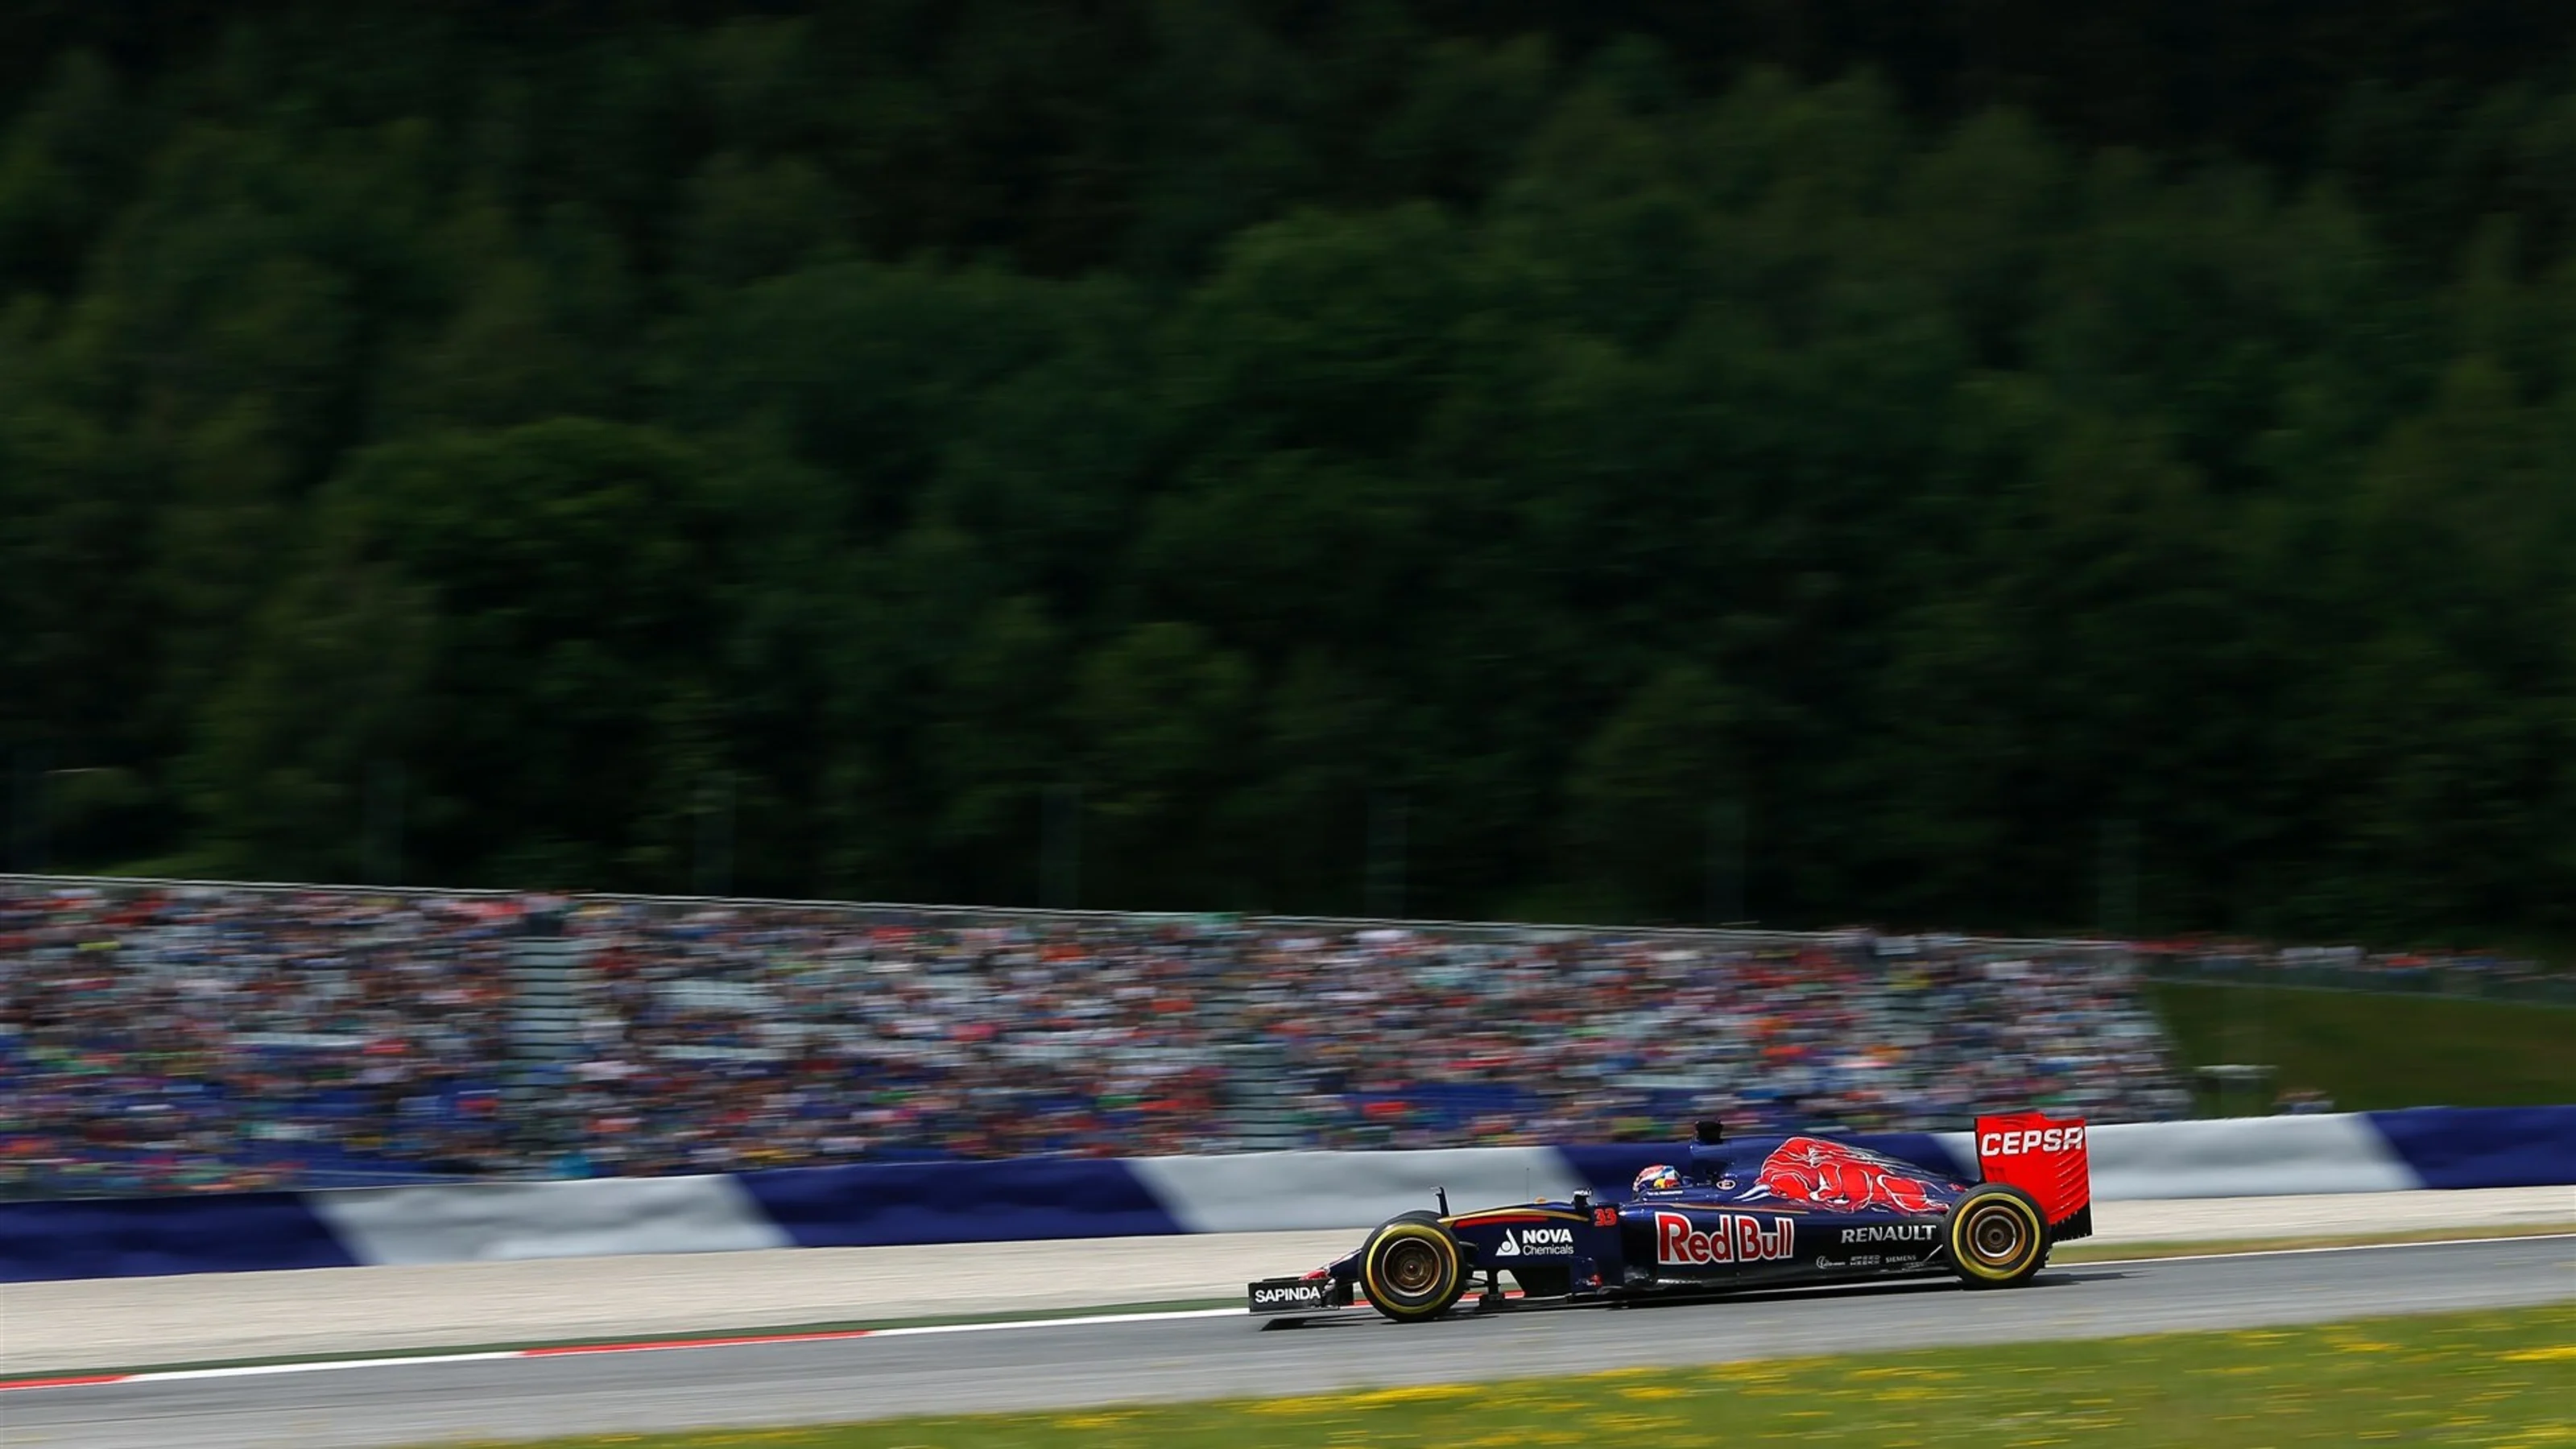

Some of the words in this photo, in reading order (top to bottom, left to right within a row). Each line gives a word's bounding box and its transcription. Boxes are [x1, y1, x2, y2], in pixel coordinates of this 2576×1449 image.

[1981, 1127, 2083, 1157] CEPSA
[1594, 1208, 1617, 1227] 33
[1522, 1228, 1573, 1244] NOVA
[1656, 1212, 1734, 1264] Red
[1735, 1215, 1794, 1261] Bull
[1841, 1224, 1937, 1244] RENAULT
[1523, 1245, 1574, 1256] Chemicals
[1885, 1254, 1916, 1264] SIEMENS
[1255, 1286, 1321, 1303] SAPINDA
